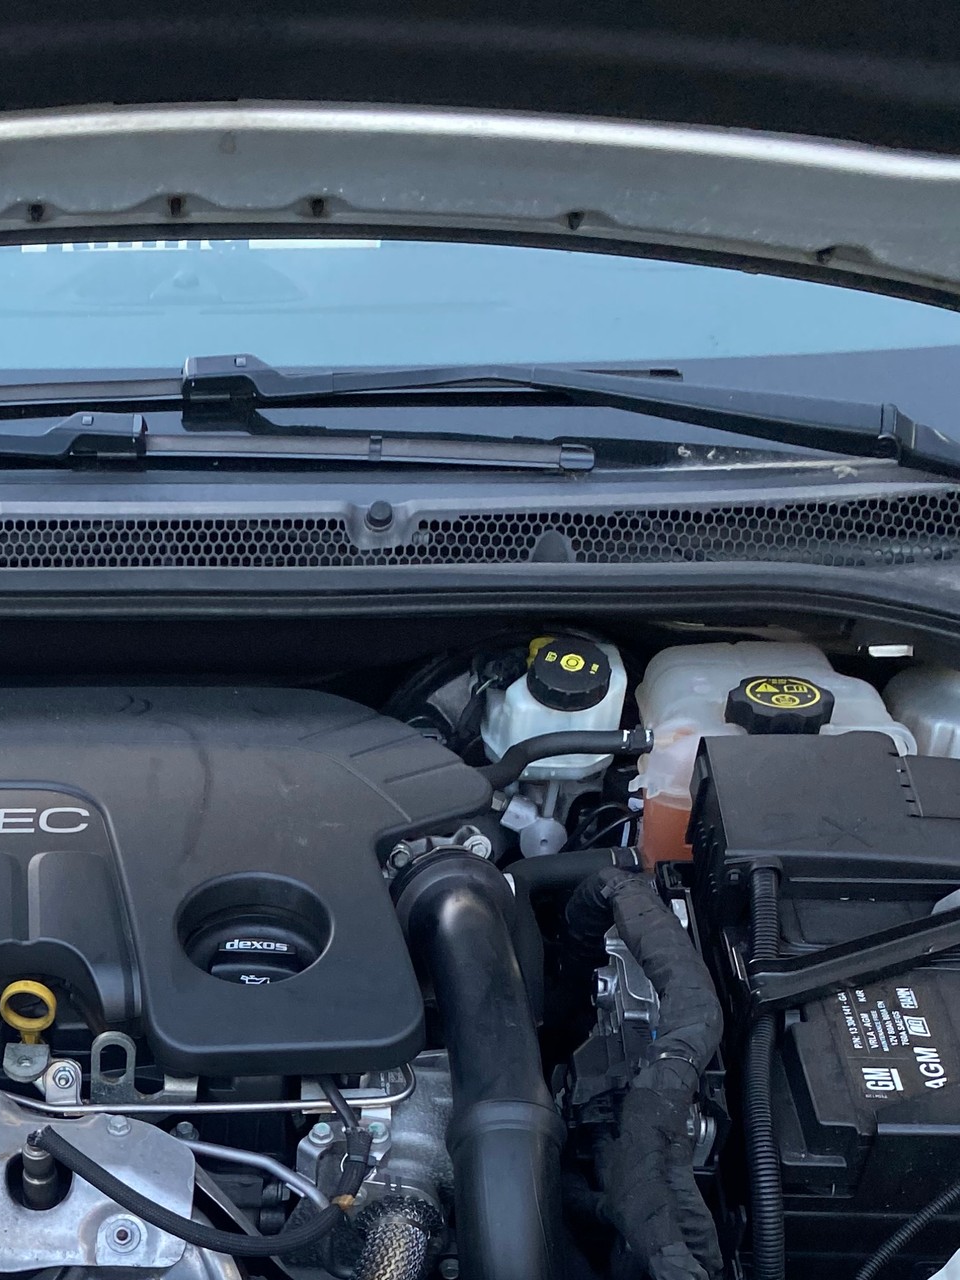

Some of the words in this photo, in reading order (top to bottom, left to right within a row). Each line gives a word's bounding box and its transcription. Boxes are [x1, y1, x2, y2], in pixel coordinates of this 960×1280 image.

[225, 939, 288, 952] dexos
[861, 1067, 895, 1091] GM
[913, 1047, 947, 1089] AGM
